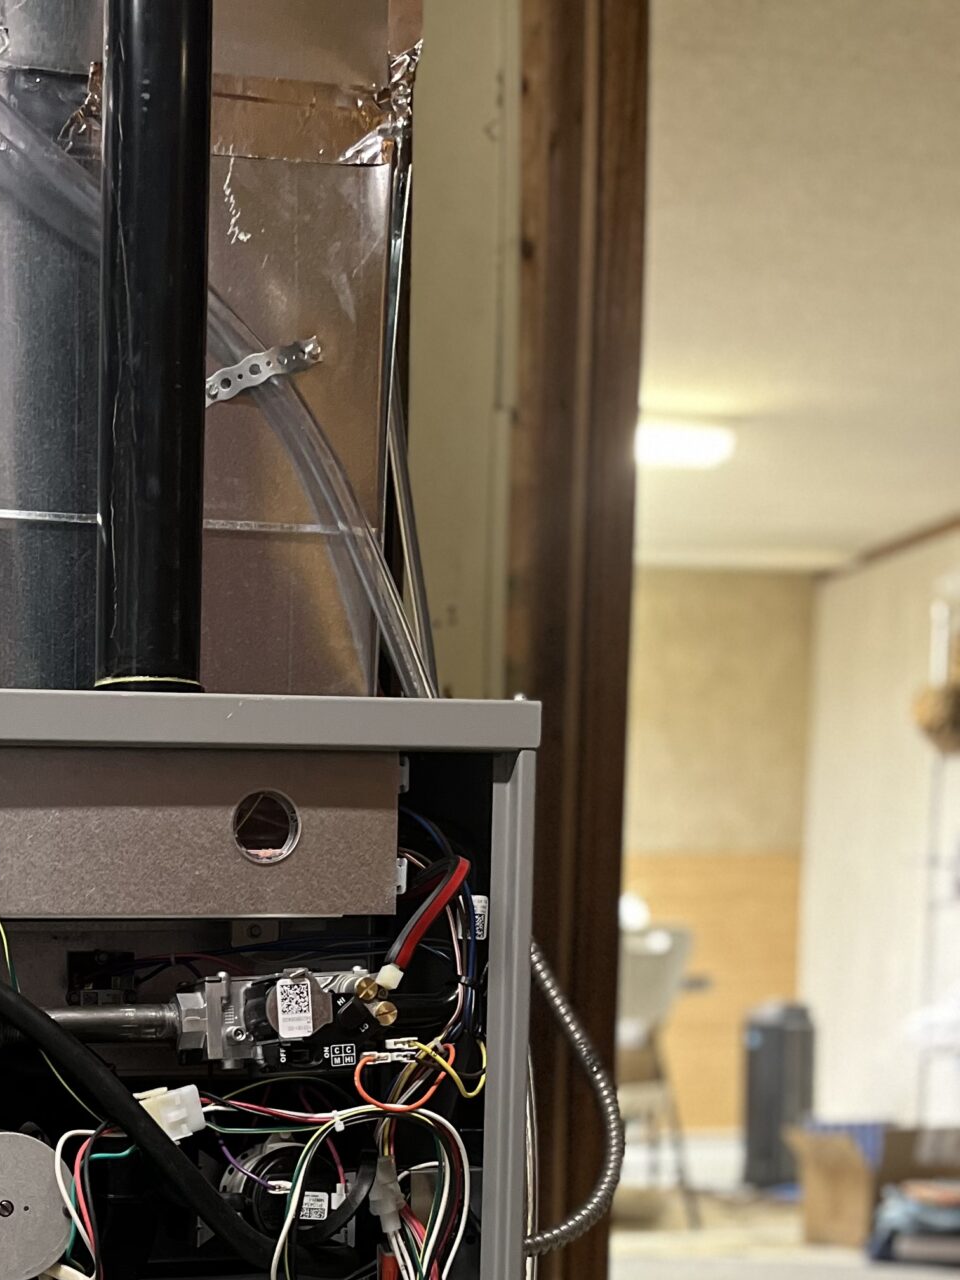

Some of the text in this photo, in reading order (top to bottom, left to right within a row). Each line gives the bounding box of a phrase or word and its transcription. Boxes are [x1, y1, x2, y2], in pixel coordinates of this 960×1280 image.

[337, 997, 346, 1006] HI
[360, 1023, 369, 1032] LO
[323, 1046, 330, 1058] ON
